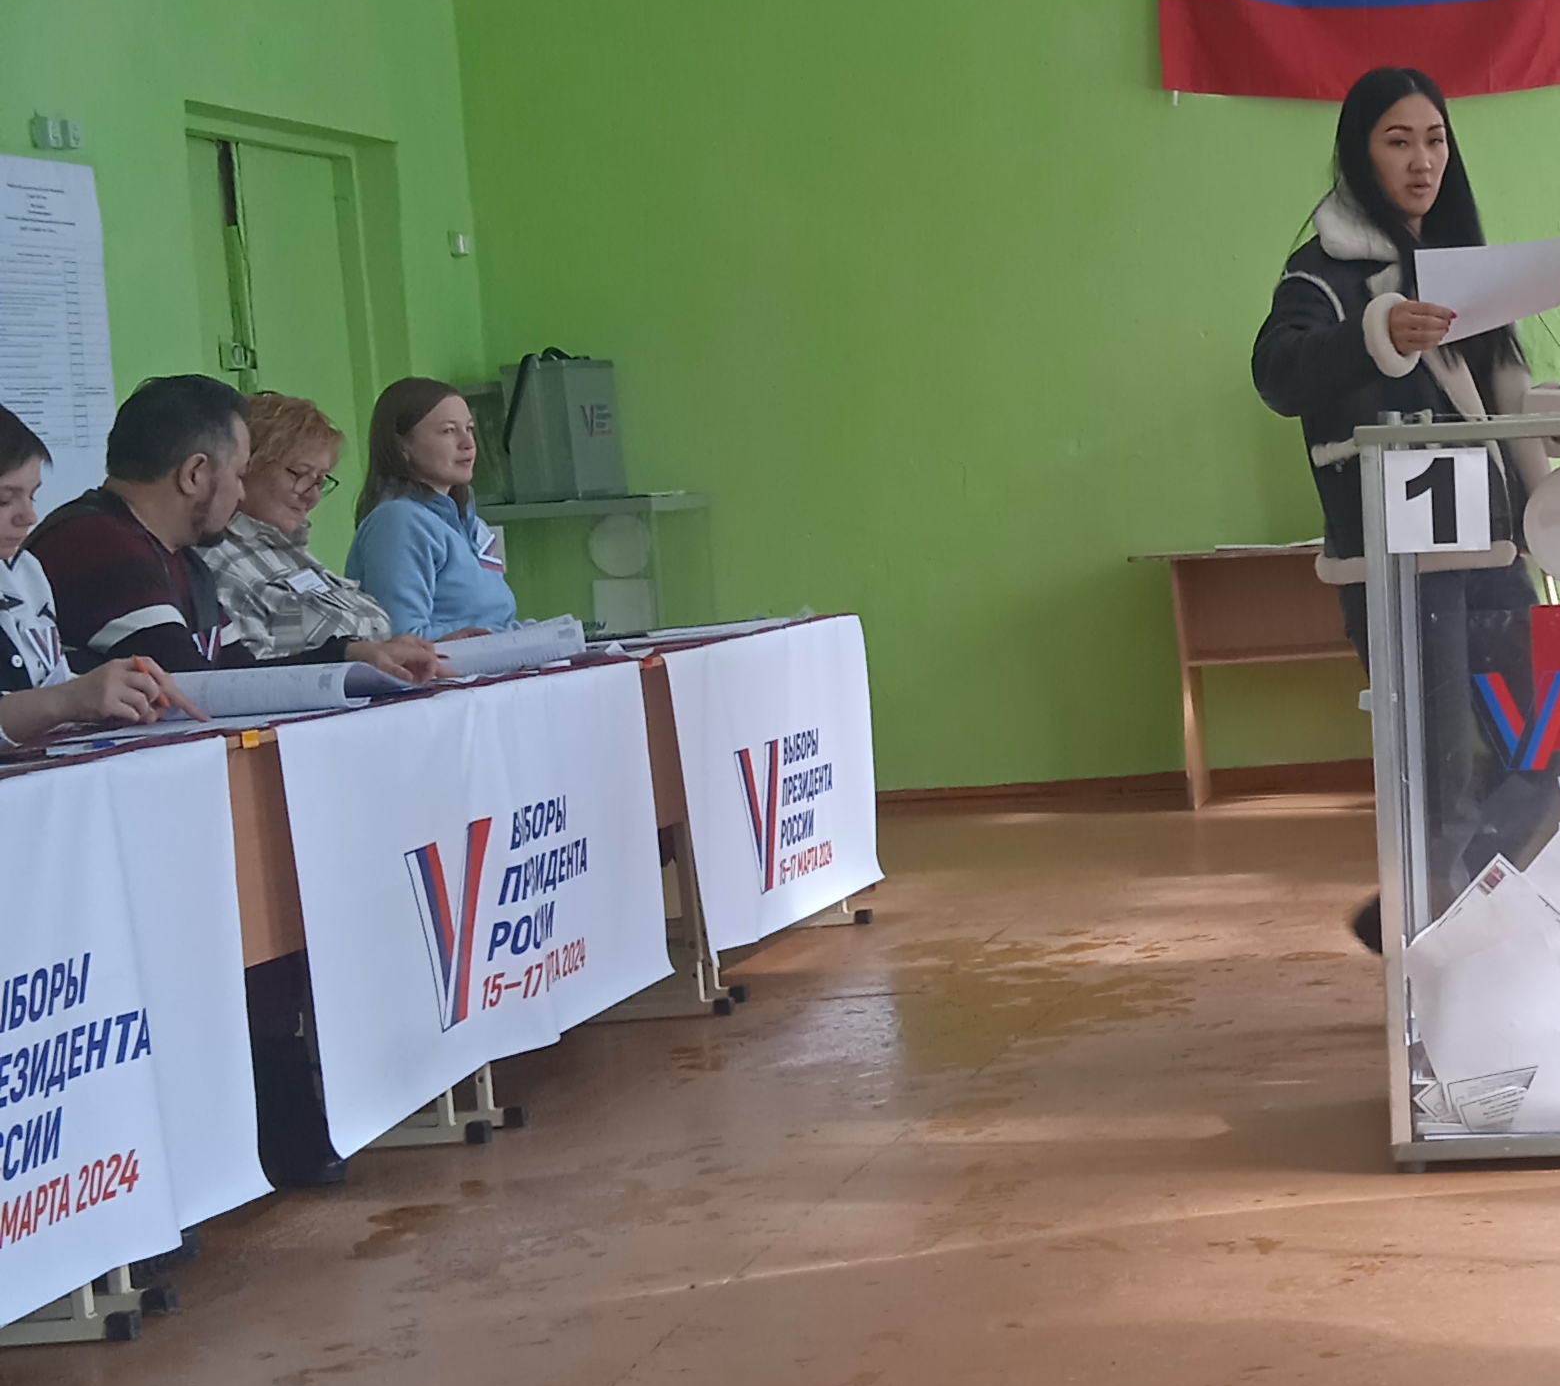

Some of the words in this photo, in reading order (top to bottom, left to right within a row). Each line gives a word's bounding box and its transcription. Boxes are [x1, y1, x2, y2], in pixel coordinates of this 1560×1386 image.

[1405, 456, 1458, 544] 1
[783, 728, 819, 766] ВЫБОРЫ
[782, 763, 833, 807] ПРЕЗИДЕНТА
[780, 808, 815, 849] РОССИИ
[498, 837, 588, 906] ПРИДЕНТА
[797, 846, 818, 877] МАРТА
[818, 840, 833, 868] 2024
[562, 937, 587, 977] 2024
[0, 1173, 70, 1249] МАРТА
[76, 1149, 139, 1213] 2024
